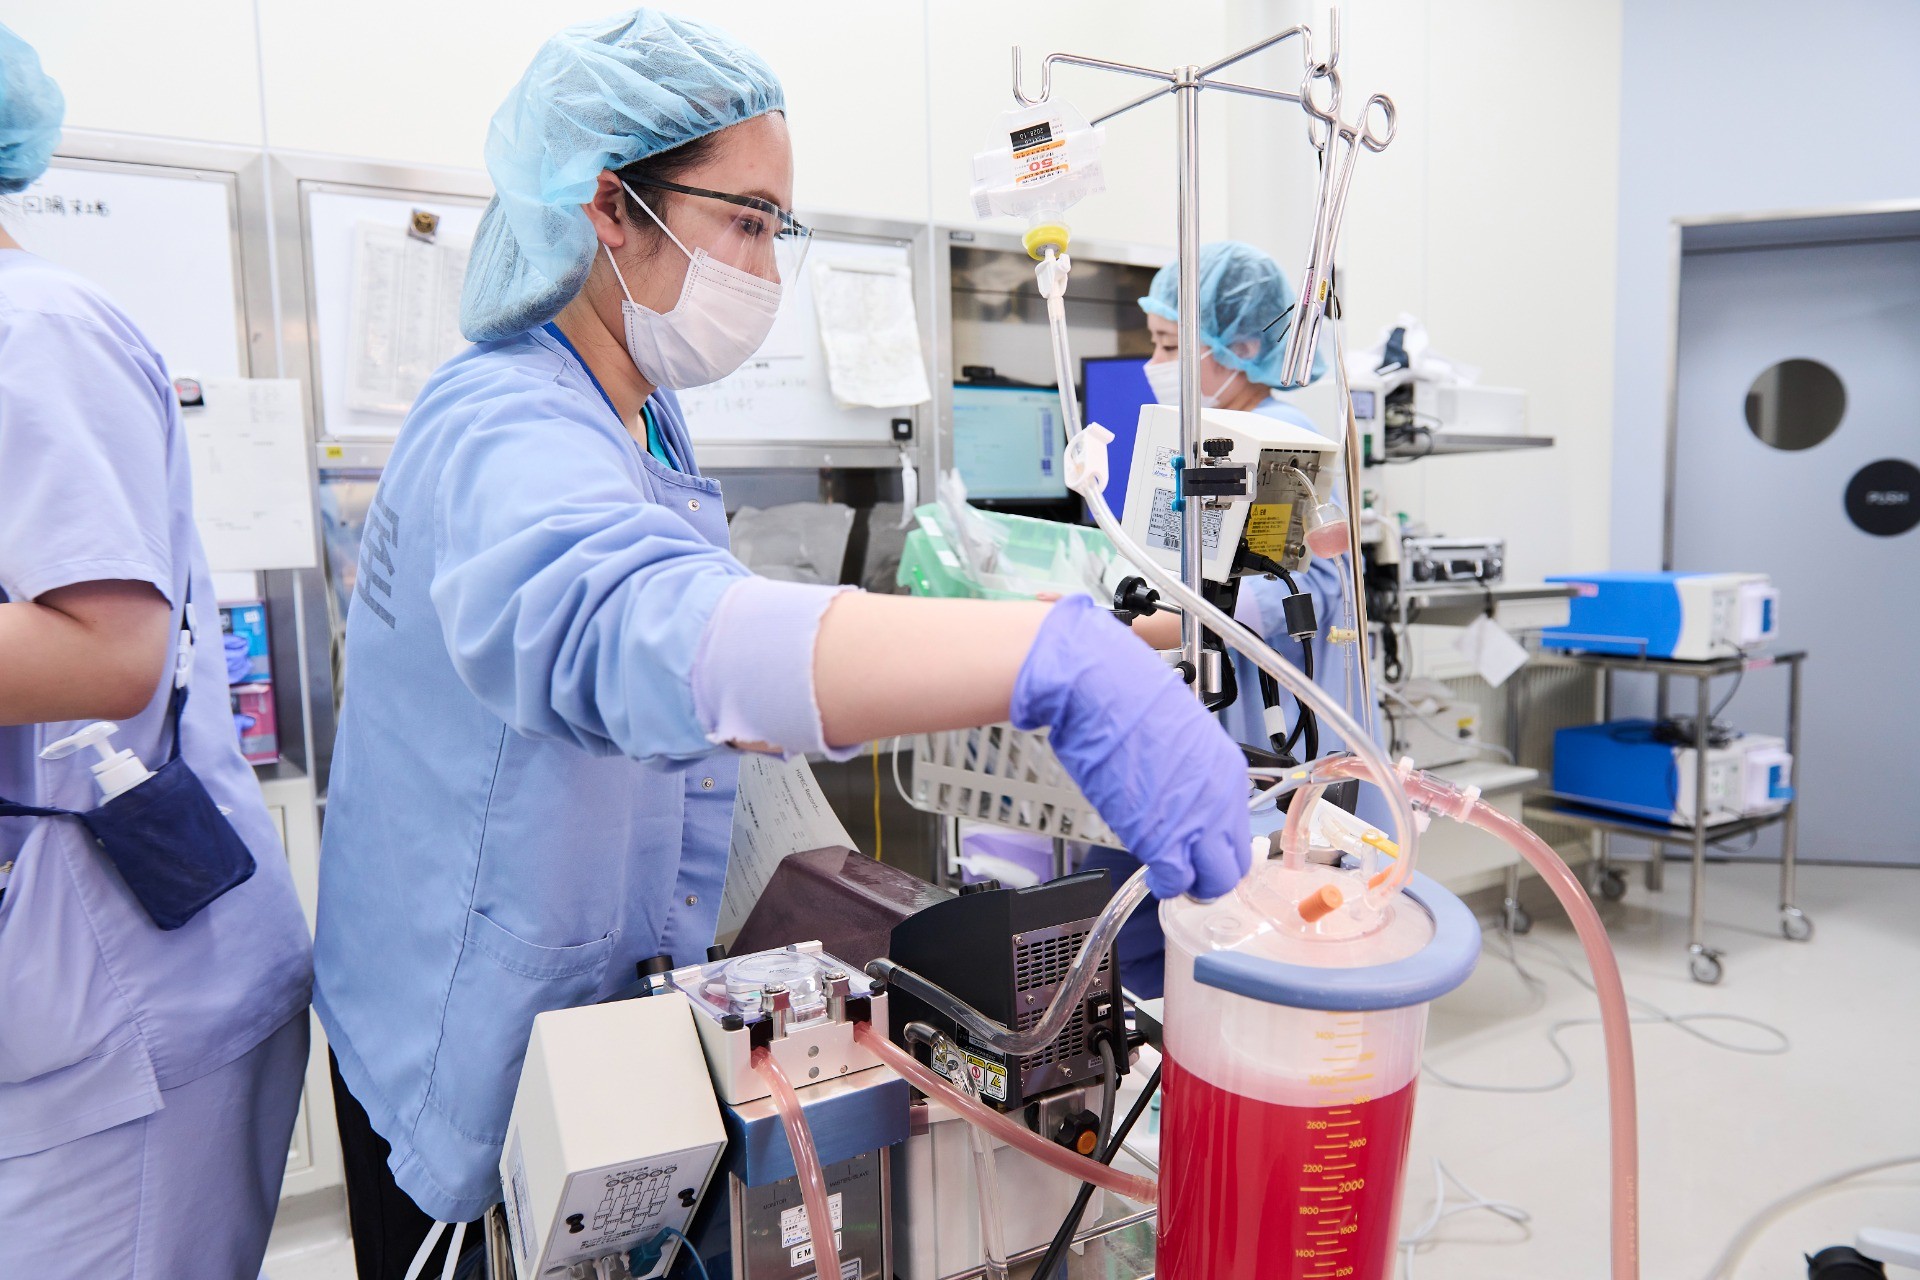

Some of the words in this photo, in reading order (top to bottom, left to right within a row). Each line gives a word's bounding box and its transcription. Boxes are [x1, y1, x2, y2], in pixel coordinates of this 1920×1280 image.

[1029, 157, 1053, 172] 50
[1867, 490, 1910, 506] PUSH
[1306, 1120, 1327, 1130] 2600
[1349, 1138, 1367, 1149] 2400
[1303, 1164, 1323, 1173] 2200
[1338, 1179, 1365, 1194] 2000
[1299, 1206, 1319, 1215] 1800
[1340, 1224, 1358, 1235] 1600
[1295, 1249, 1315, 1258] 1400
[1336, 1266, 1353, 1278] 1200
